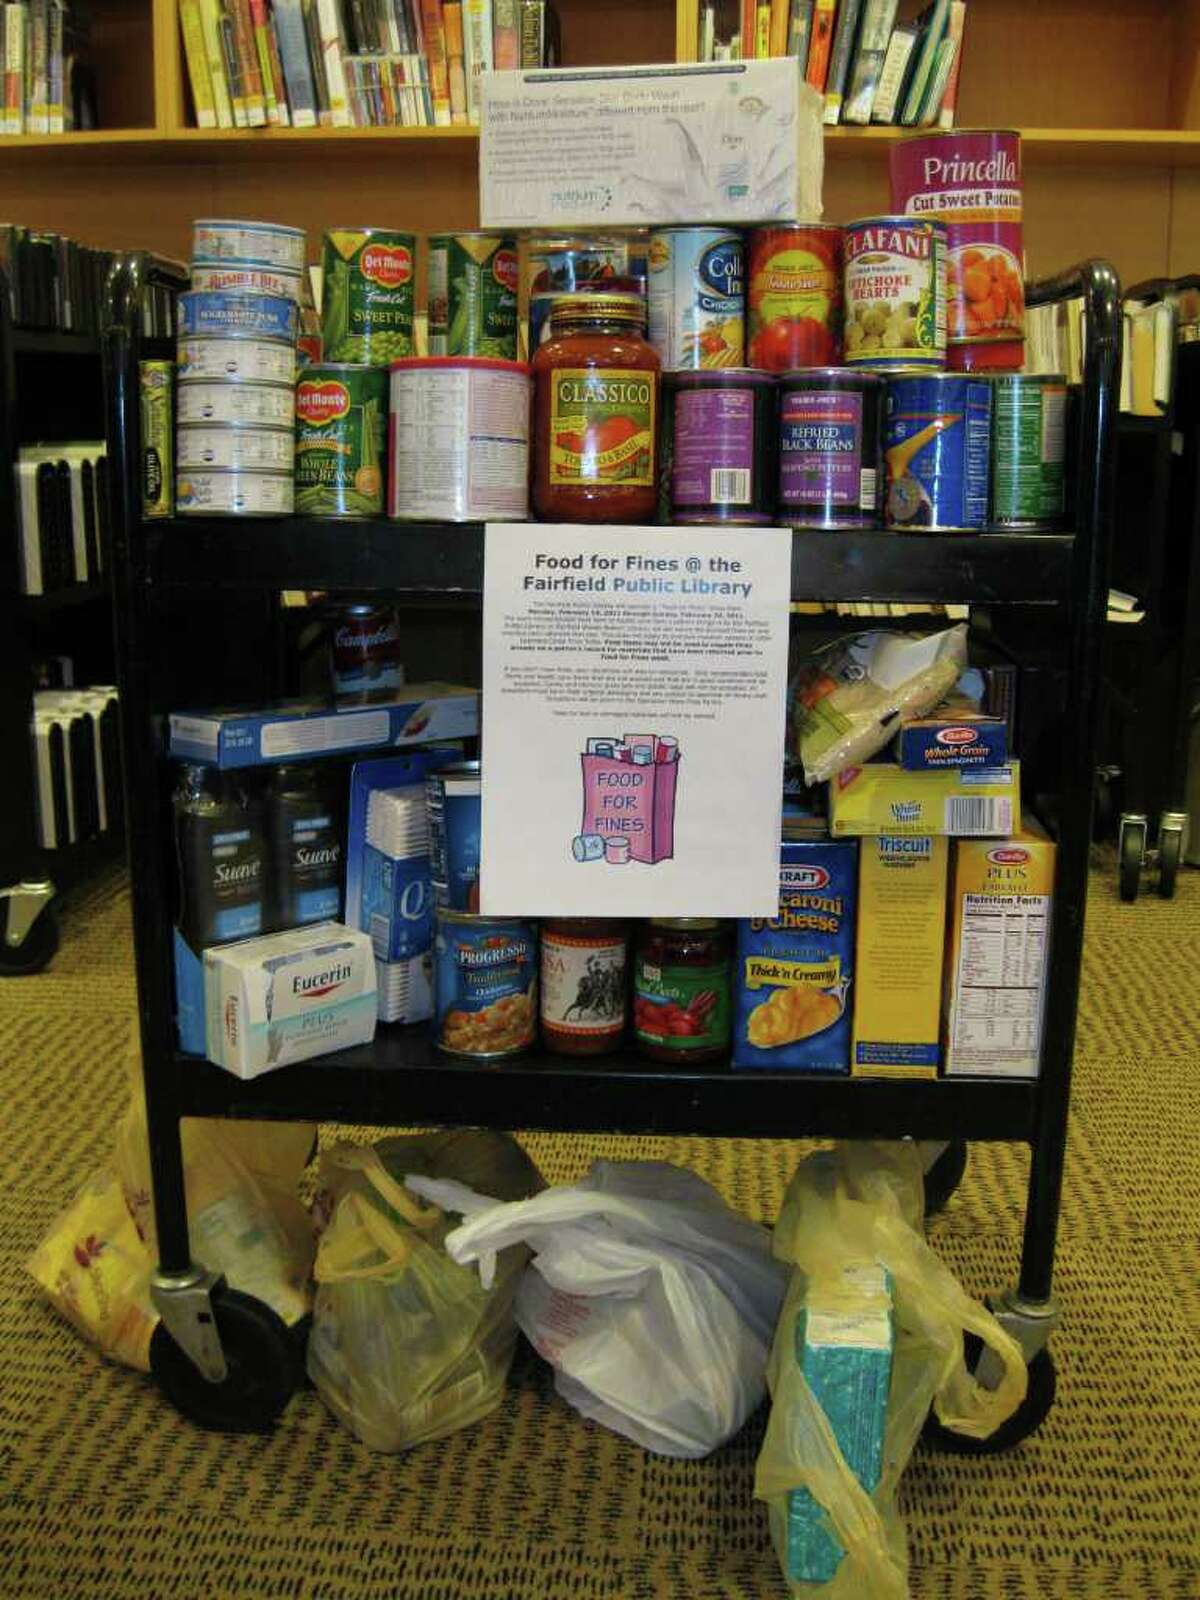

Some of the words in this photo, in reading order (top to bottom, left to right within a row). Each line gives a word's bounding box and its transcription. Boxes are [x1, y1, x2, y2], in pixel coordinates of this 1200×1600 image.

[923, 151, 1016, 185] Princella
[913, 196, 935, 211] Cut
[938, 193, 980, 208] Sweet
[365, 255, 382, 268] Del
[354, 311, 391, 325] SWEET
[560, 383, 649, 403] CLASSICO
[816, 439, 853, 451] BEANS
[535, 554, 583, 570] Food
[589, 553, 619, 571] for
[626, 555, 679, 572] Fines
[685, 557, 702, 573] @
[708, 556, 742, 573] the
[523, 576, 606, 593] Fairfield
[613, 577, 675, 594] Public
[681, 578, 752, 598] Library
[925, 744, 959, 759] Whole
[960, 744, 990, 756] Grain
[597, 772, 643, 787] FOOD
[602, 795, 638, 809] FOR
[594, 817, 645, 832] FINES
[878, 836, 930, 853] Triscuit
[214, 861, 261, 885] Suave
[987, 867, 1027, 880] PLUS
[967, 896, 1013, 904] Nutrition
[1016, 896, 1042, 905] Facts
[459, 943, 527, 965] PROGRESSO
[293, 964, 352, 994] Eucerin
[750, 963, 780, 977] Thick
[792, 967, 837, 983] Creamy
